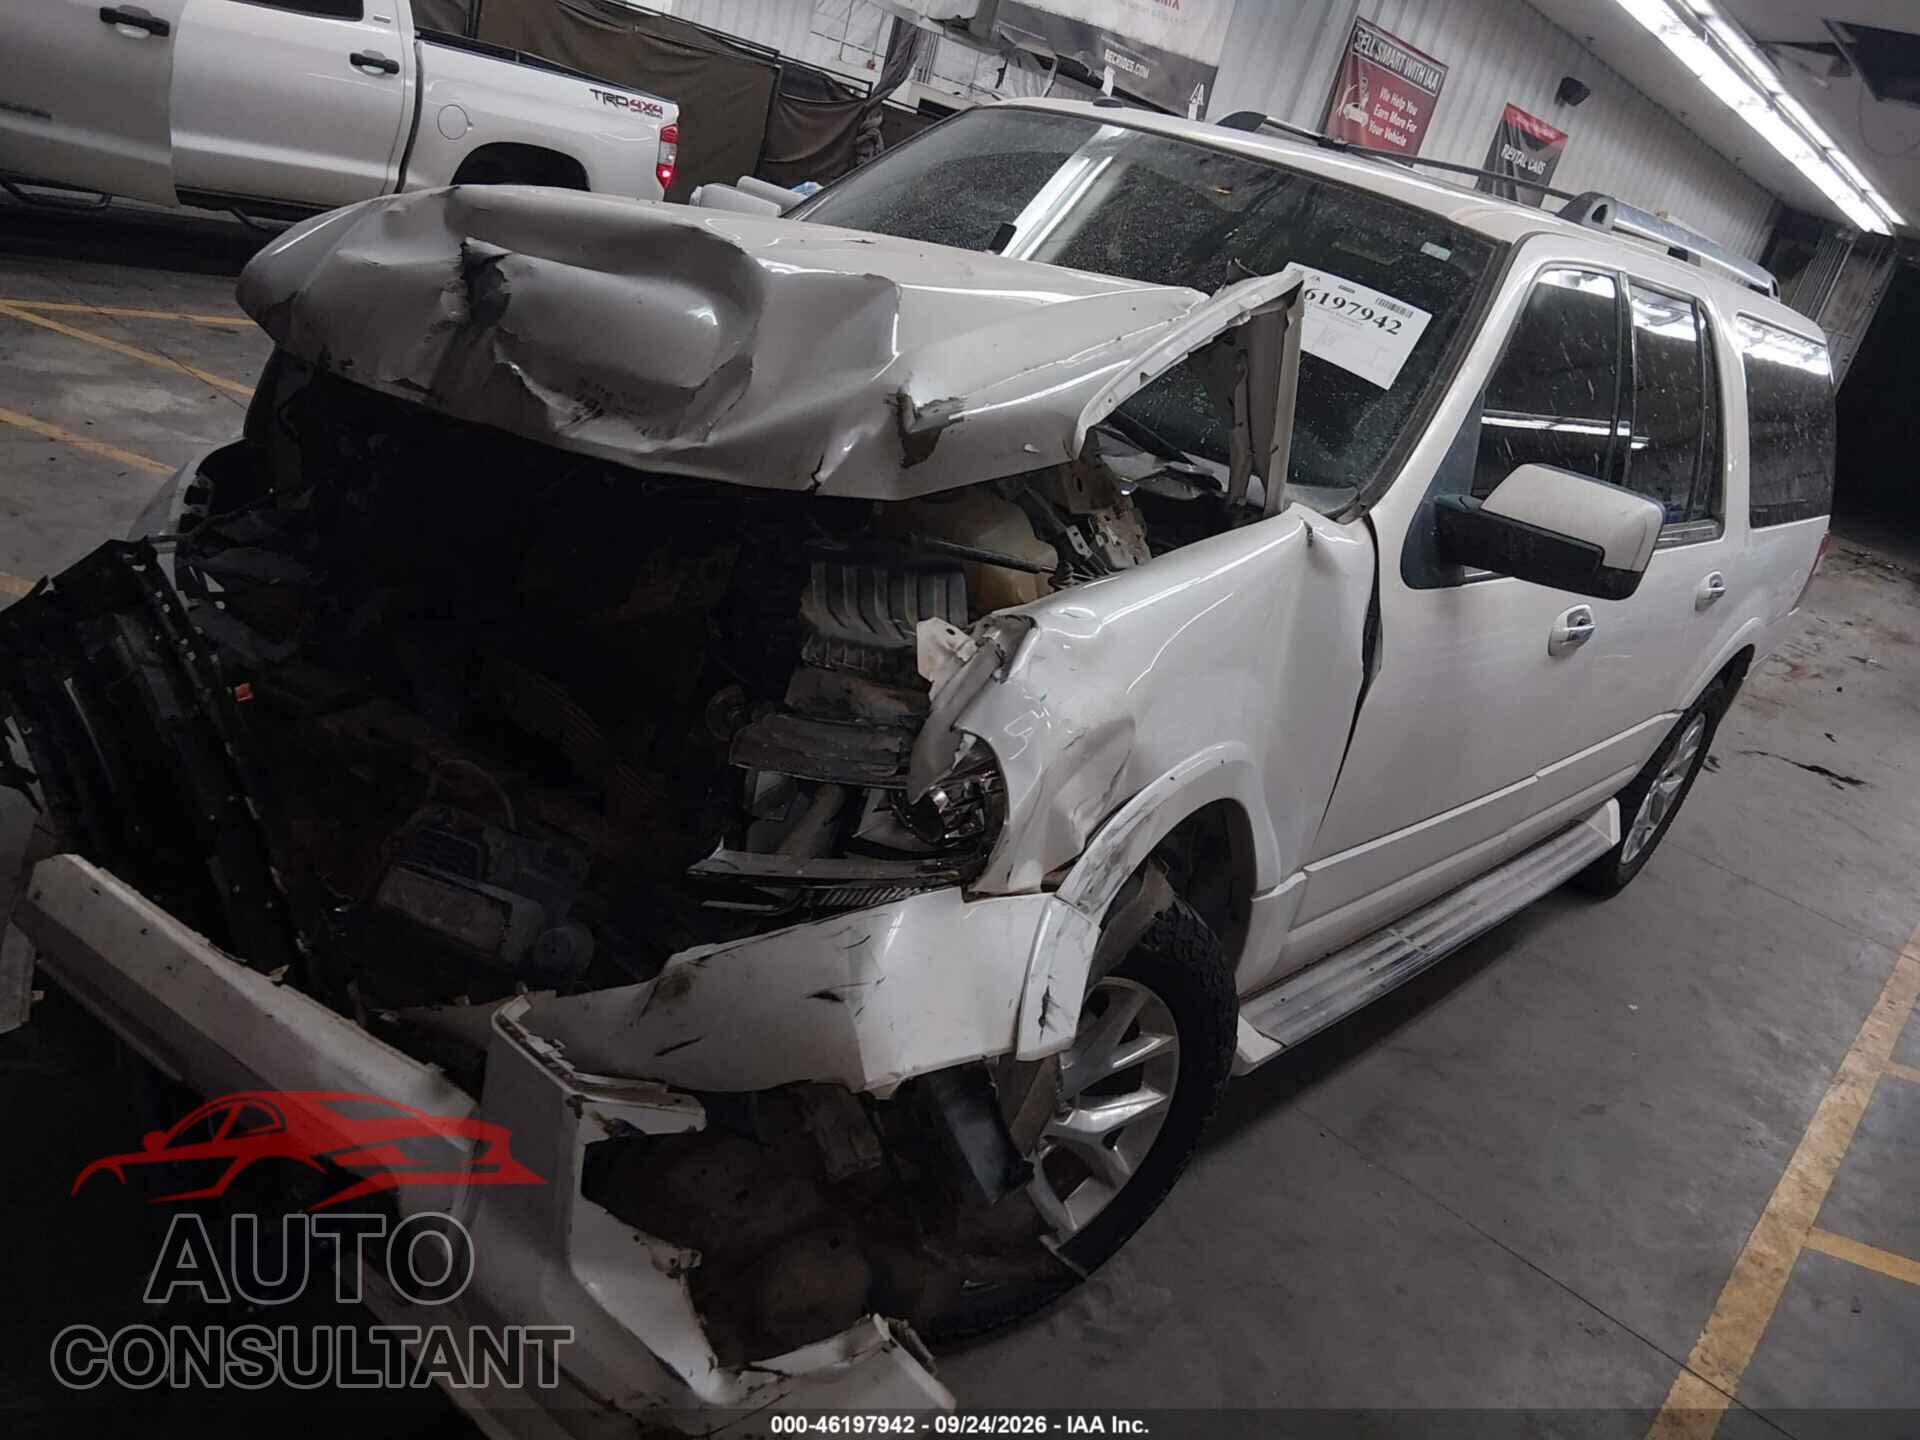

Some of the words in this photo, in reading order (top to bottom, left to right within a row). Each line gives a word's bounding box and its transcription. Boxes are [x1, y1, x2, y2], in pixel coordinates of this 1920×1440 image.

[1354, 29, 1376, 57] SELL
[1375, 42, 1406, 72] SMART
[1404, 59, 1426, 83] WITH
[1373, 103, 1389, 120] Earn
[1389, 111, 1406, 128] More
[1406, 119, 1417, 133] For
[1391, 93, 1406, 111] Help
[1406, 100, 1418, 116] You
[1368, 120, 1384, 136] Your
[1384, 127, 1407, 147] Vehicle
